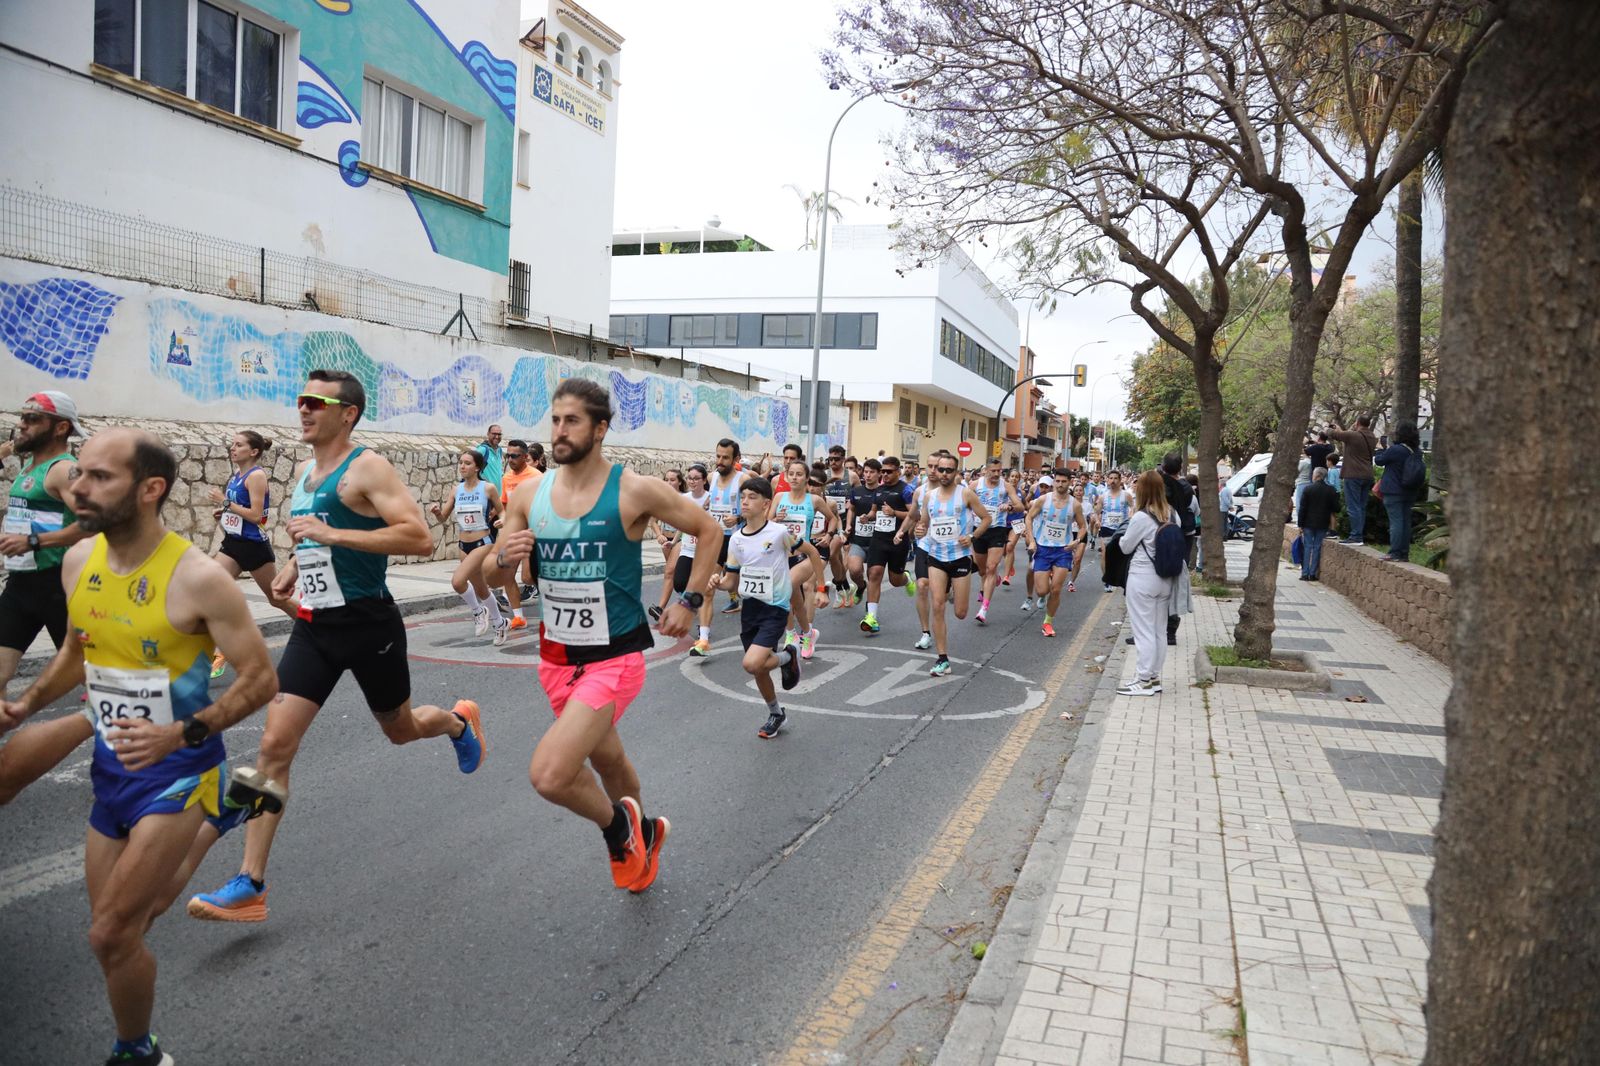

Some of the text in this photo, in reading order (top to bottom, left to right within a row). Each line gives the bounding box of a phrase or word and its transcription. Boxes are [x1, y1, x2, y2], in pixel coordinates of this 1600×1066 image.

[553, 94, 575, 116] SAFA
[585, 112, 604, 131] ICET
[225, 515, 239, 527] 360
[464, 515, 476, 524] 61
[936, 527, 953, 536] 422
[1048, 529, 1062, 538] 525
[537, 541, 607, 560] WATT
[541, 563, 605, 577] ESHMÚN
[744, 581, 766, 594] 721
[552, 606, 594, 629] 778
